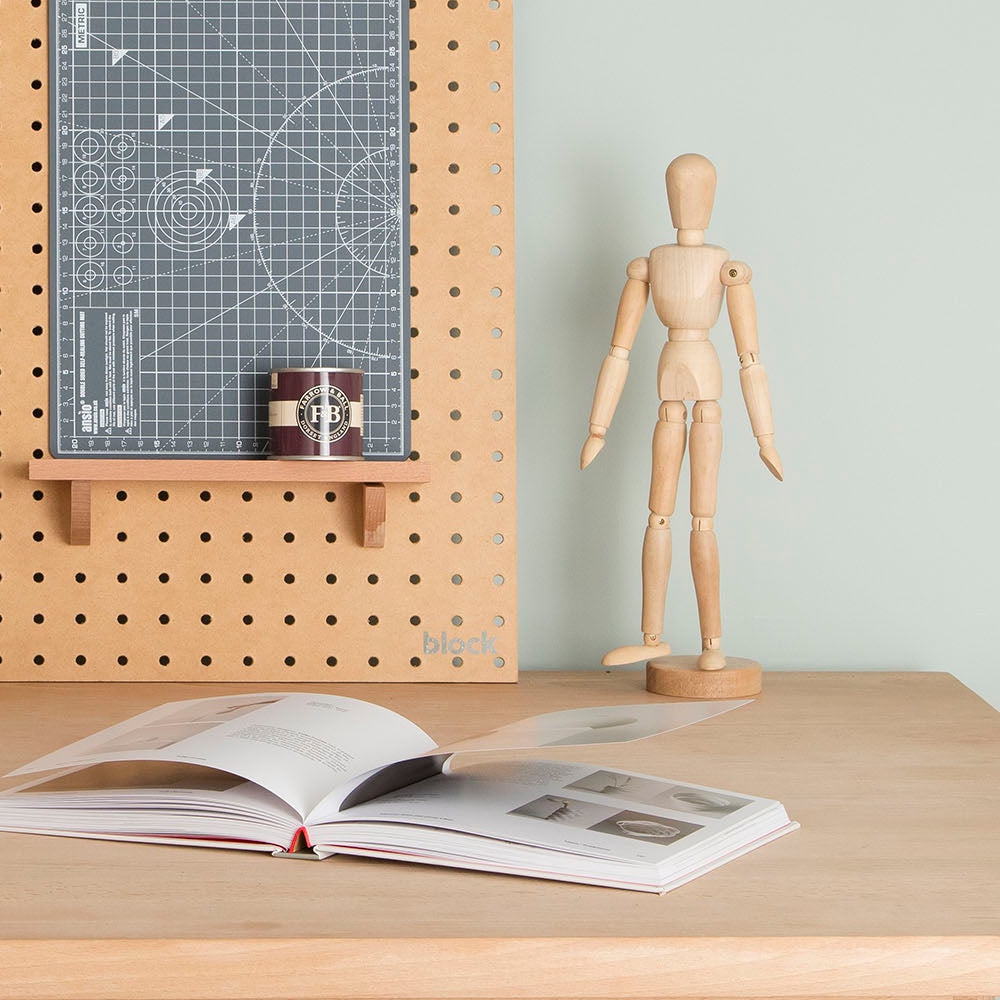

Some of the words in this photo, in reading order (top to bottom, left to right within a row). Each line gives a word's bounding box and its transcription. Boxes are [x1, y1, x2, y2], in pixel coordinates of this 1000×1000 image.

[300, 387, 328, 410] FARROW
[337, 393, 349, 410] BALL
[423, 631, 498, 655] block
